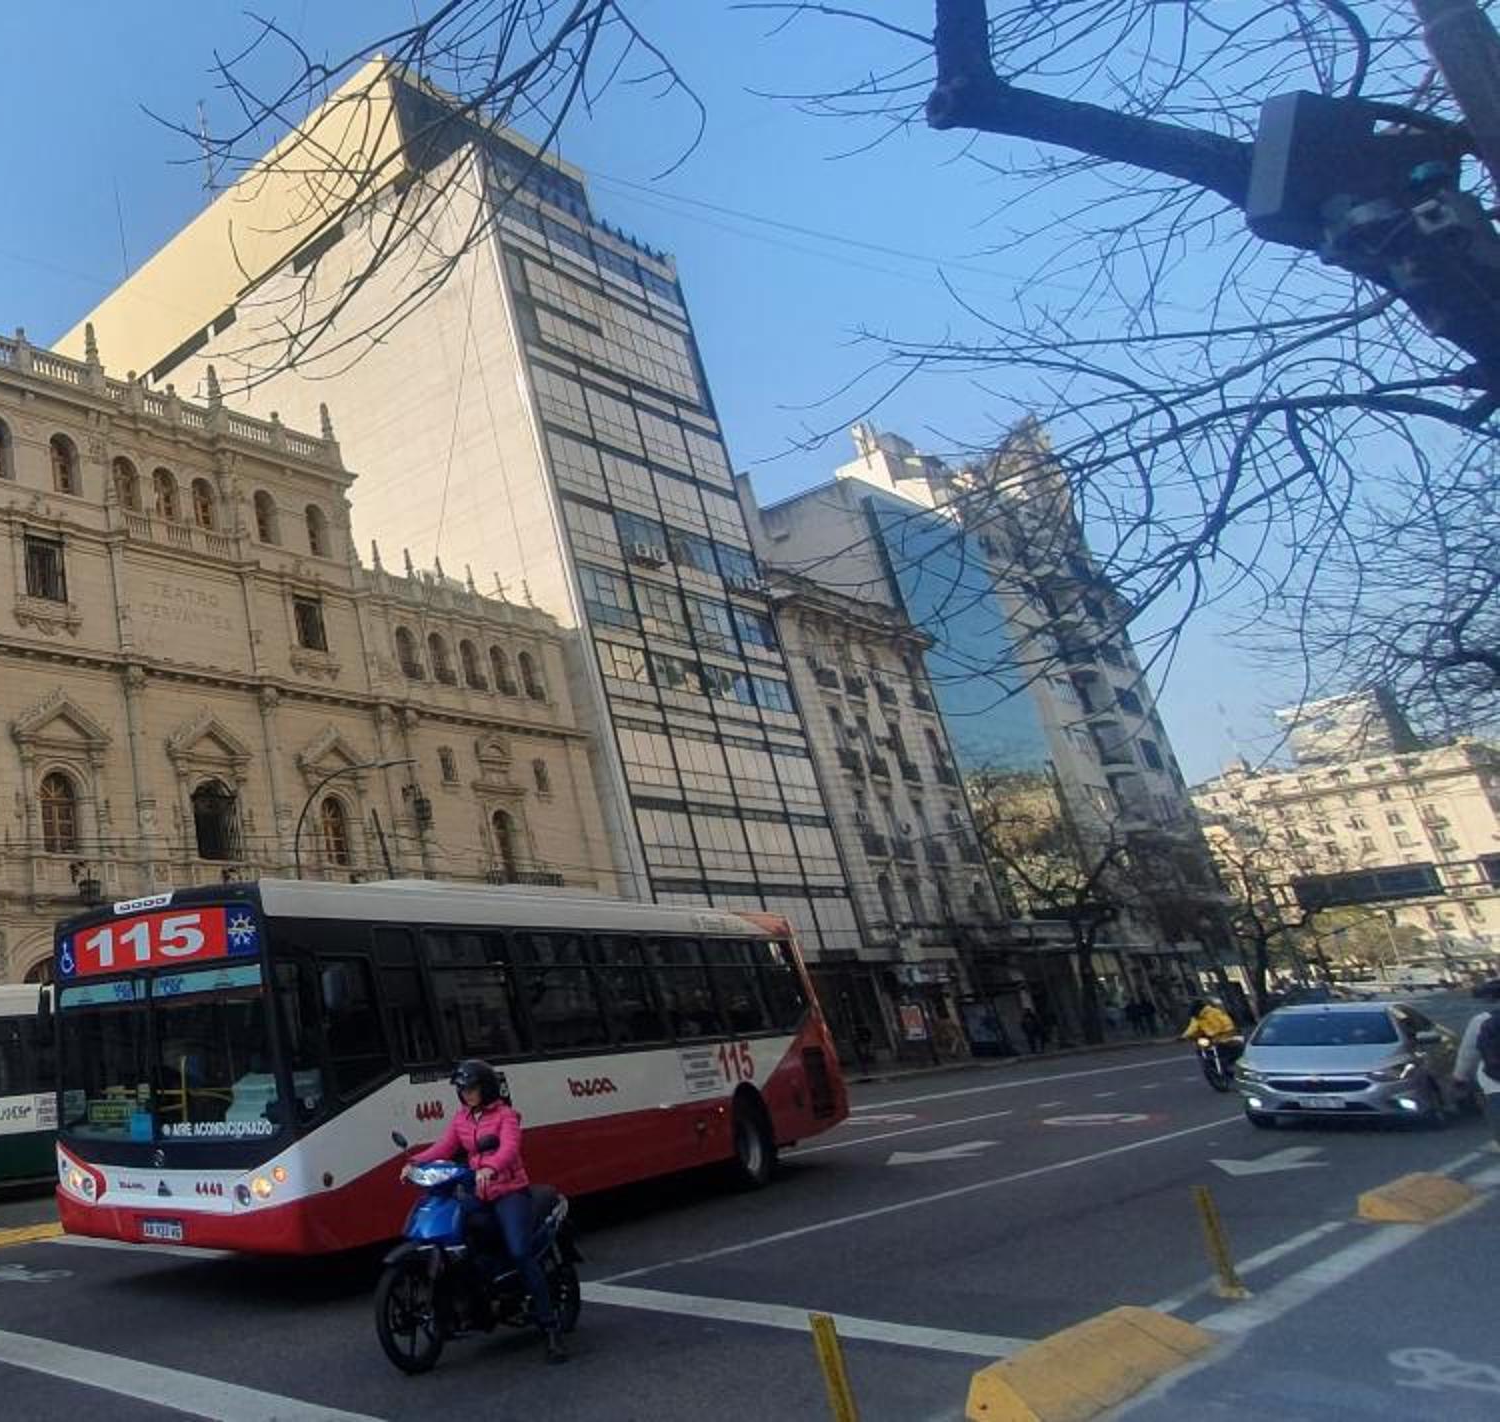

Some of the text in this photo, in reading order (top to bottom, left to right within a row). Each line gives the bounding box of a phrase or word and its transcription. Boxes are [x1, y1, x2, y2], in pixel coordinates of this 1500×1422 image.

[148, 581, 220, 609] TEATRO
[140, 602, 231, 632] CERVANTES
[86, 913, 204, 967] 115
[719, 1041, 755, 1083] 115
[172, 1118, 273, 1136] AIRE ACONDICIONADO
